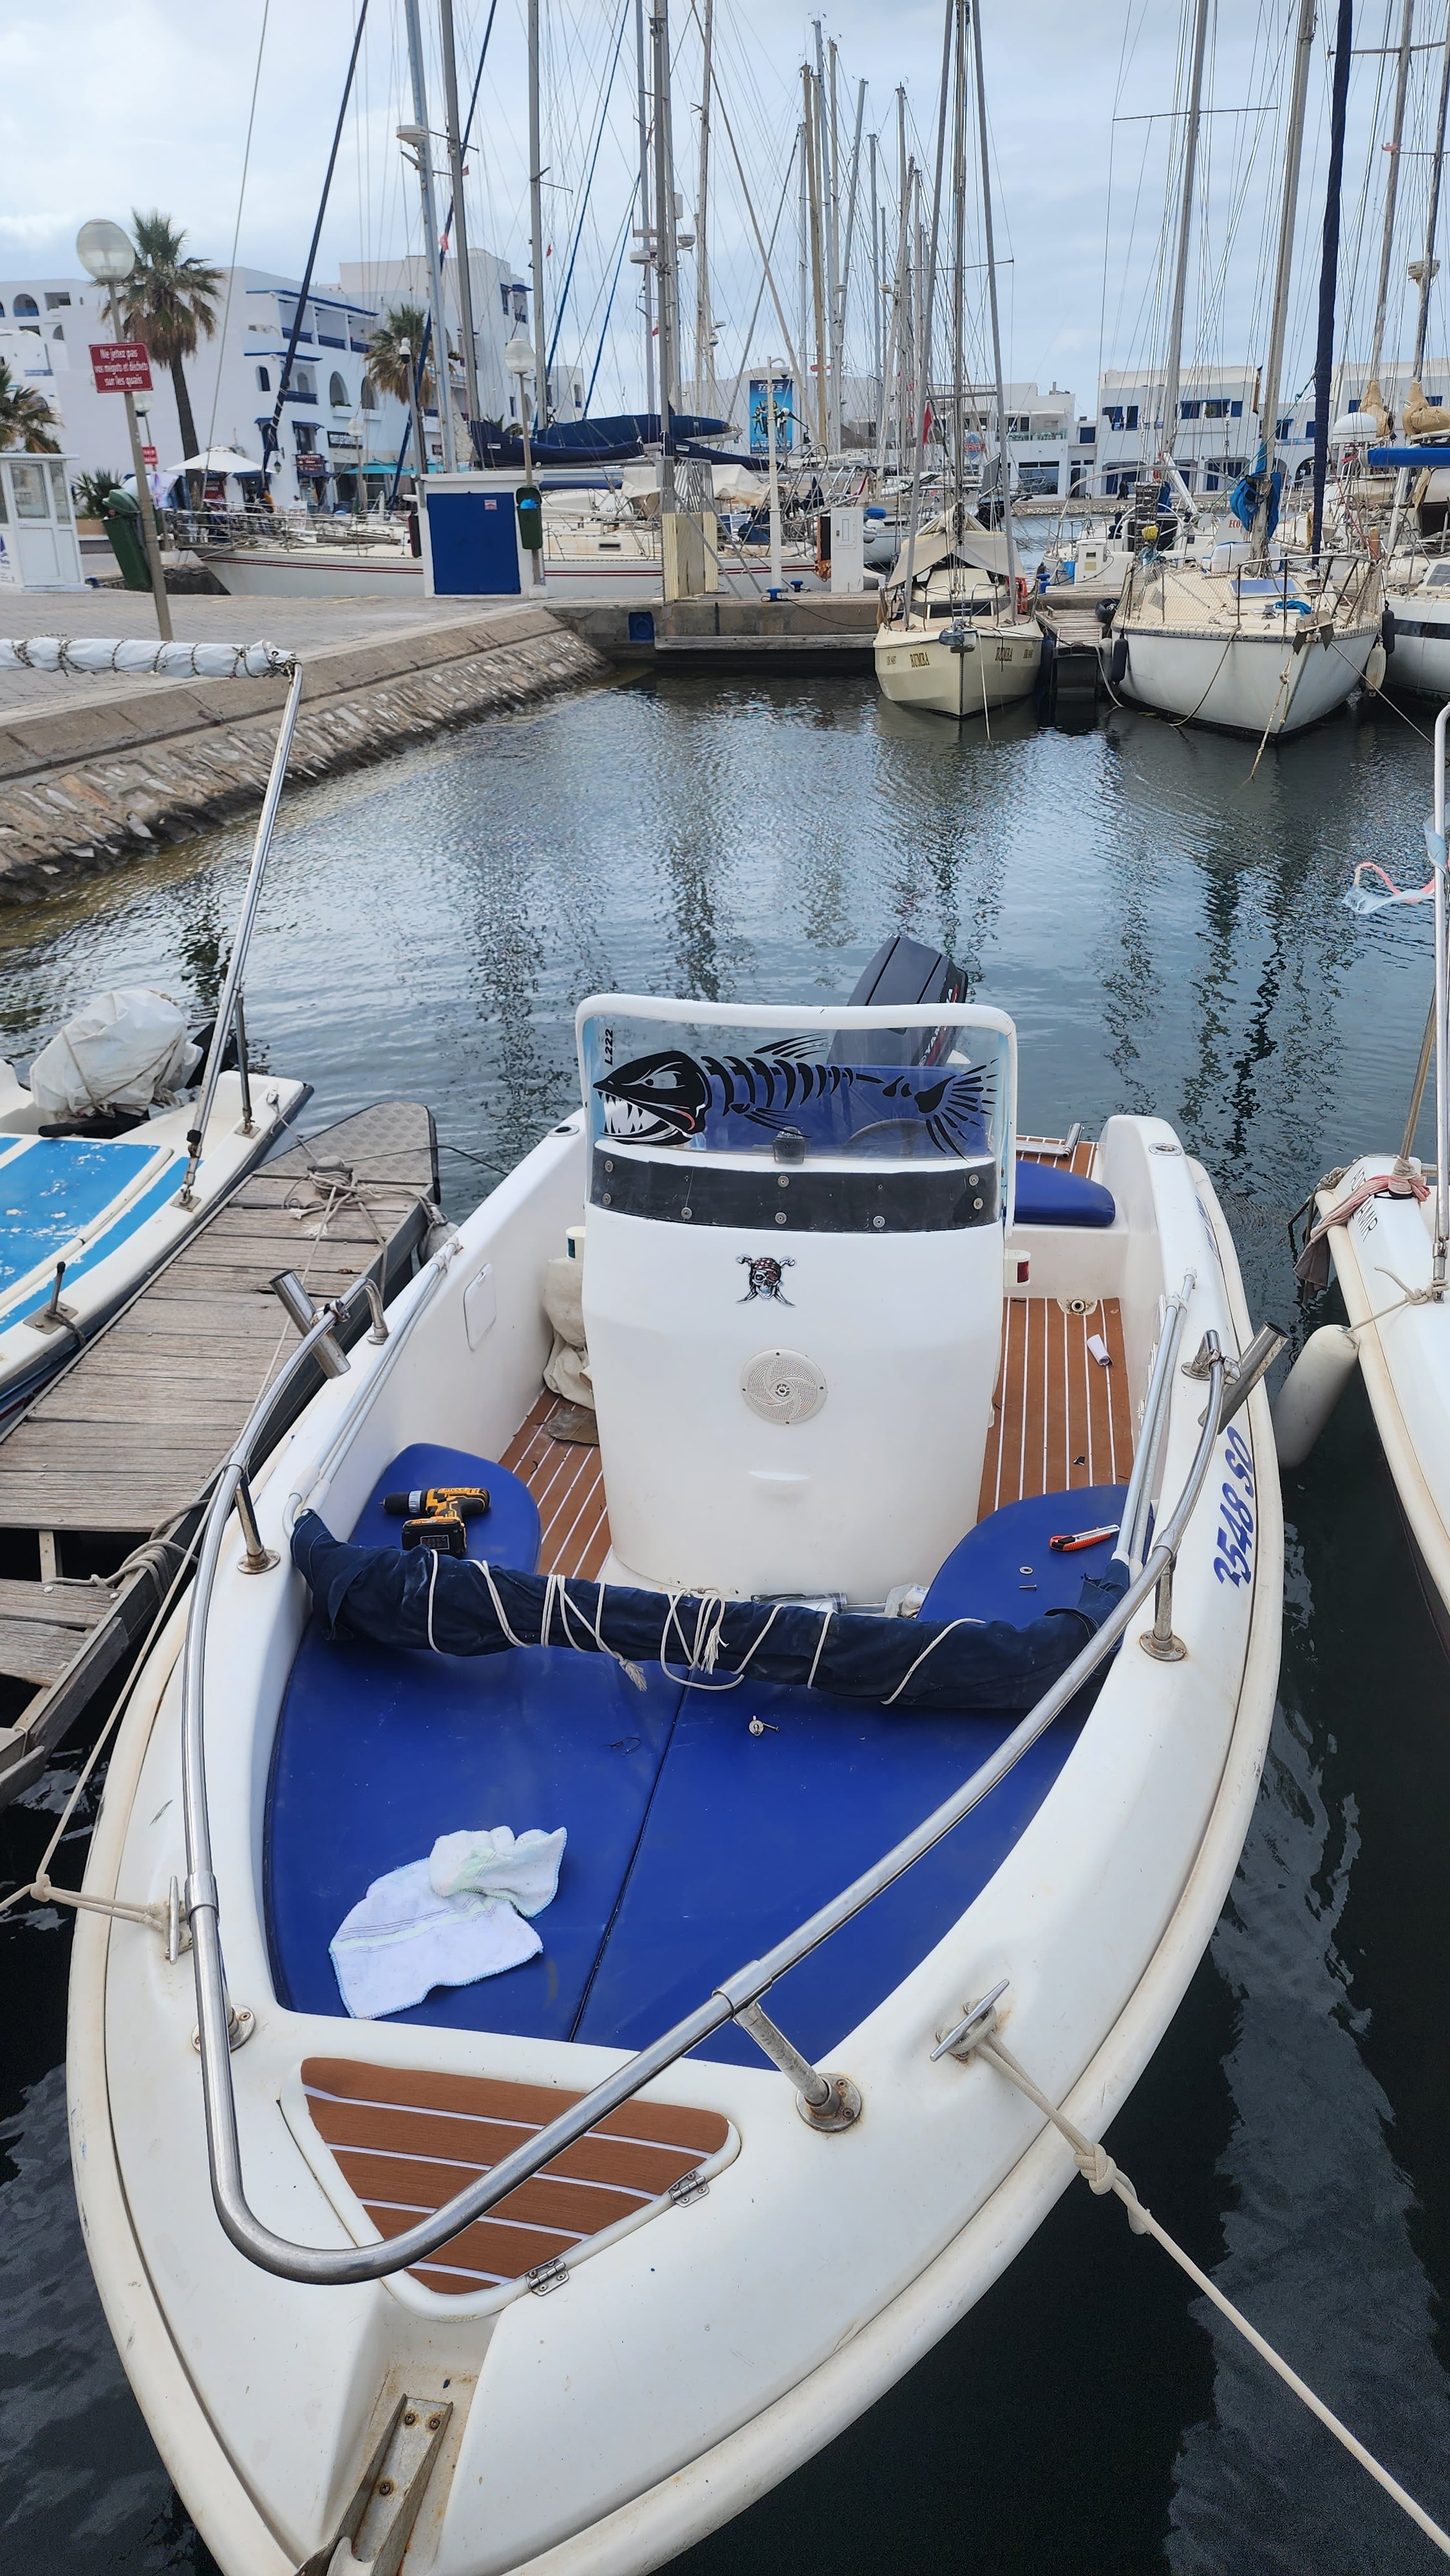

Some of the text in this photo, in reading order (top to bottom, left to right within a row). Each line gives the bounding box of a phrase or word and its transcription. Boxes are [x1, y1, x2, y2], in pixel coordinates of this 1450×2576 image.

[100, 348, 138, 361] Ne jetez pas
[115, 375, 126, 385] les
[126, 374, 143, 387] quais
[1229, 520, 1241, 528] ECO
[910, 652, 930, 668] RUMBA
[605, 1028, 613, 1066] L222
[1213, 1482, 1254, 1589] 2548
